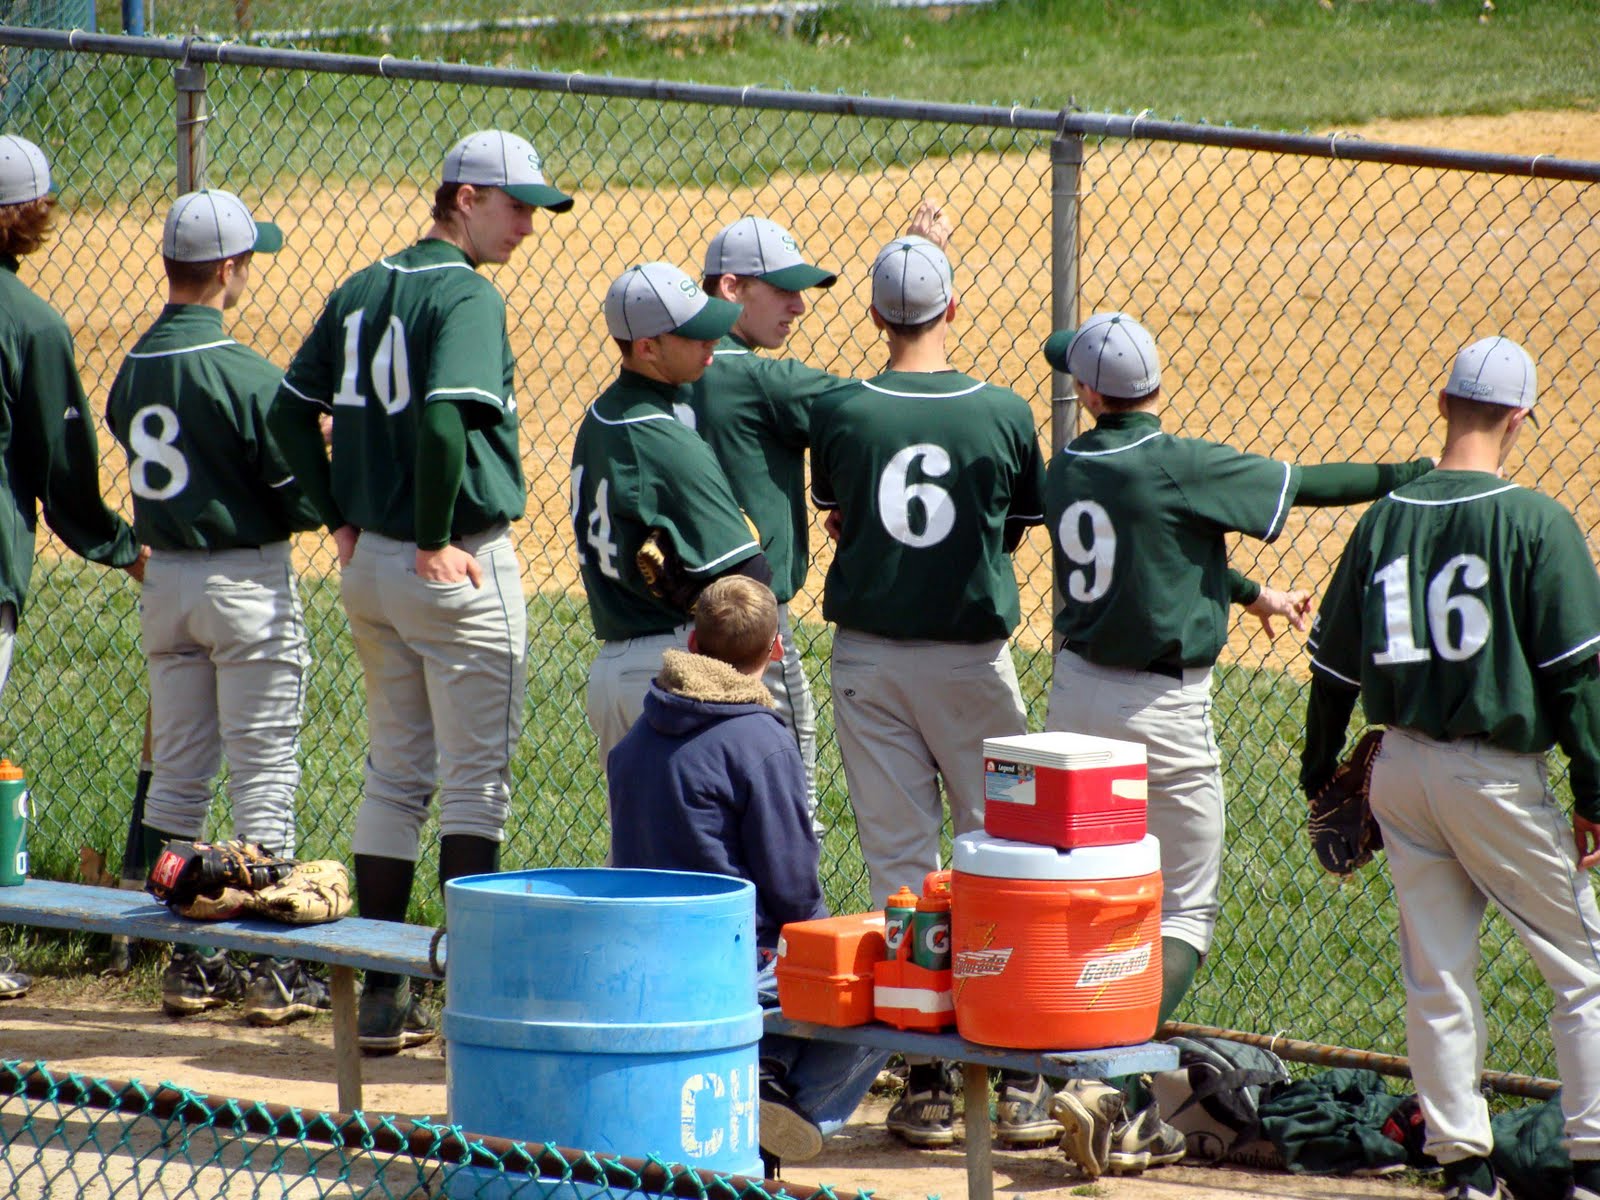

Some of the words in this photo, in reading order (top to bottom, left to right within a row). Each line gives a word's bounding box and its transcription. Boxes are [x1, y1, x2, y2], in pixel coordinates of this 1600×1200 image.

[679, 279, 698, 298] S
[333, 308, 411, 415] 10
[129, 404, 189, 500] 8
[878, 443, 956, 548] 6
[1058, 500, 1117, 604] 9
[1372, 553, 1492, 666] 16
[886, 920, 904, 950] G
[925, 924, 950, 954] G
[1081, 950, 1150, 984] Gatorade
[920, 1104, 950, 1121] NIKE
